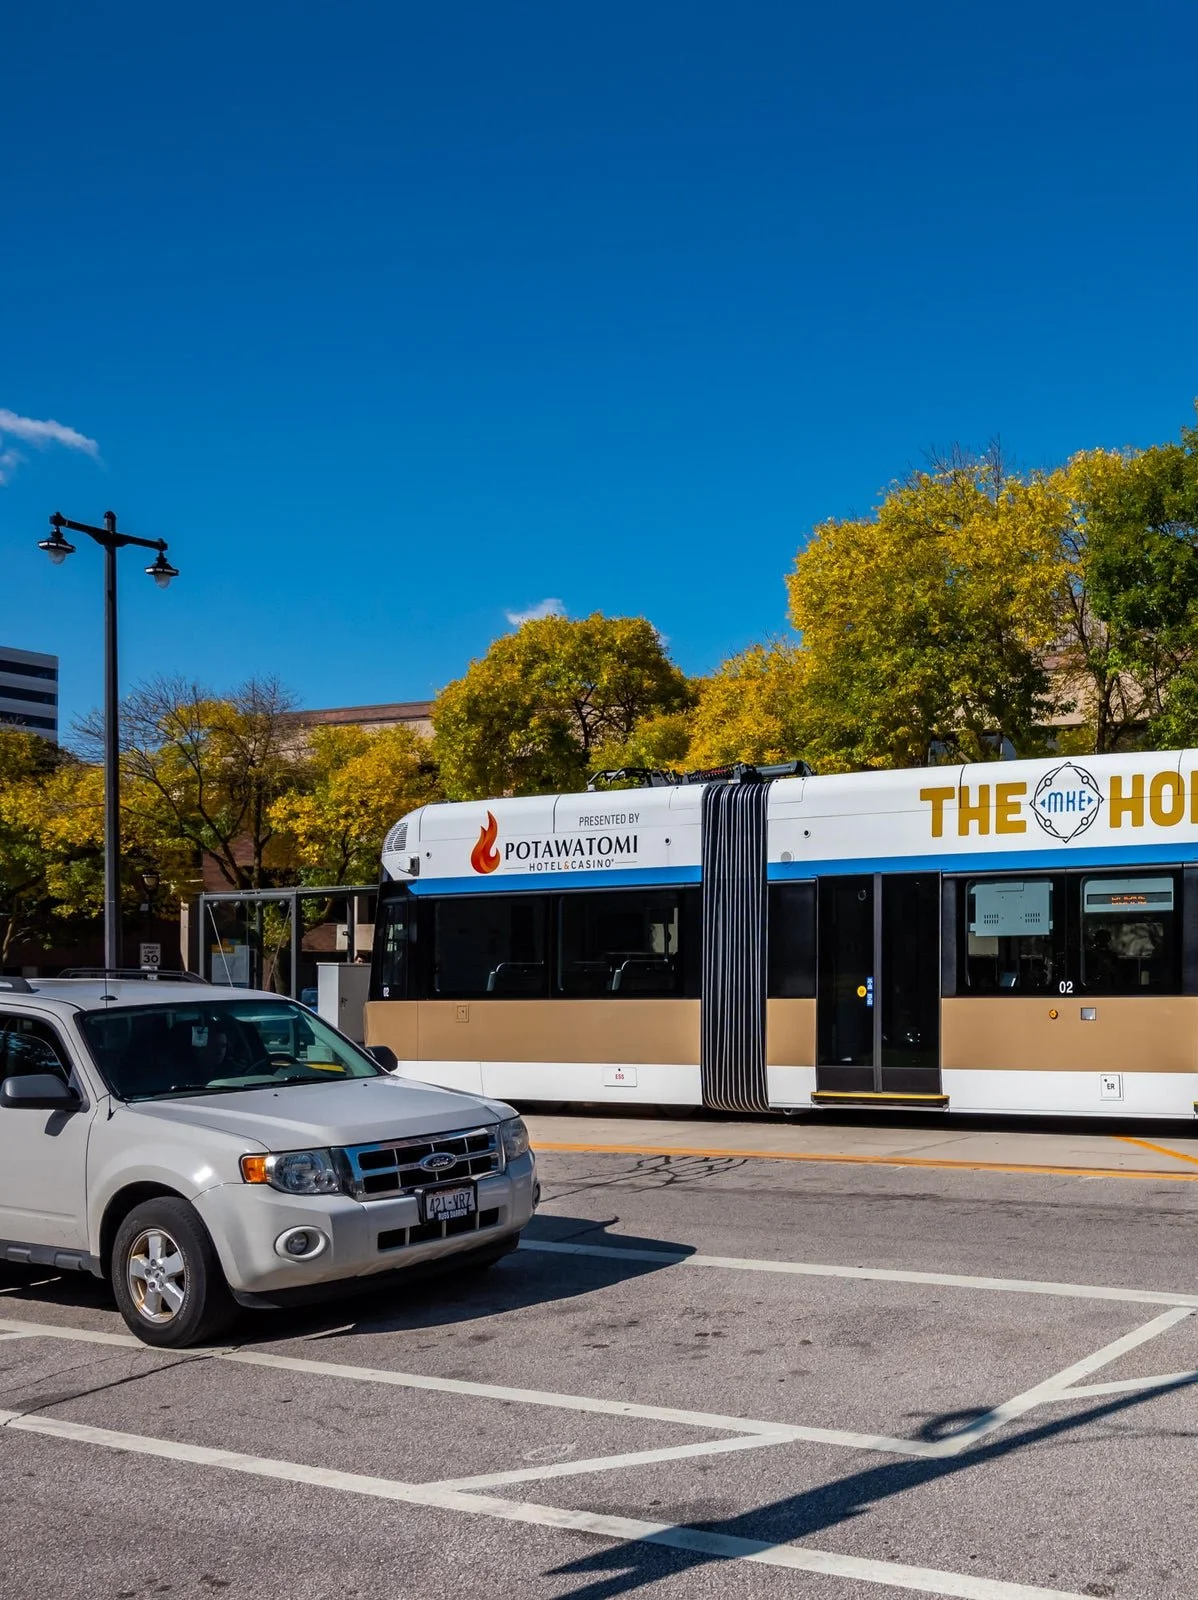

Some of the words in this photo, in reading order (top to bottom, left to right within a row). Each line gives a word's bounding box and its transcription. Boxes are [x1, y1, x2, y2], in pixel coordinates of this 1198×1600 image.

[919, 781, 1028, 838] THE
[1047, 789, 1087, 814] MKE
[578, 814, 627, 827] PRESENTED
[628, 812, 641, 824] BY
[504, 834, 639, 861] POTAWATOMI
[143, 954, 159, 963] 30
[1059, 980, 1074, 994] 02
[1106, 1082, 1116, 1090] ER
[430, 1192, 472, 1212] 421-VRZ
